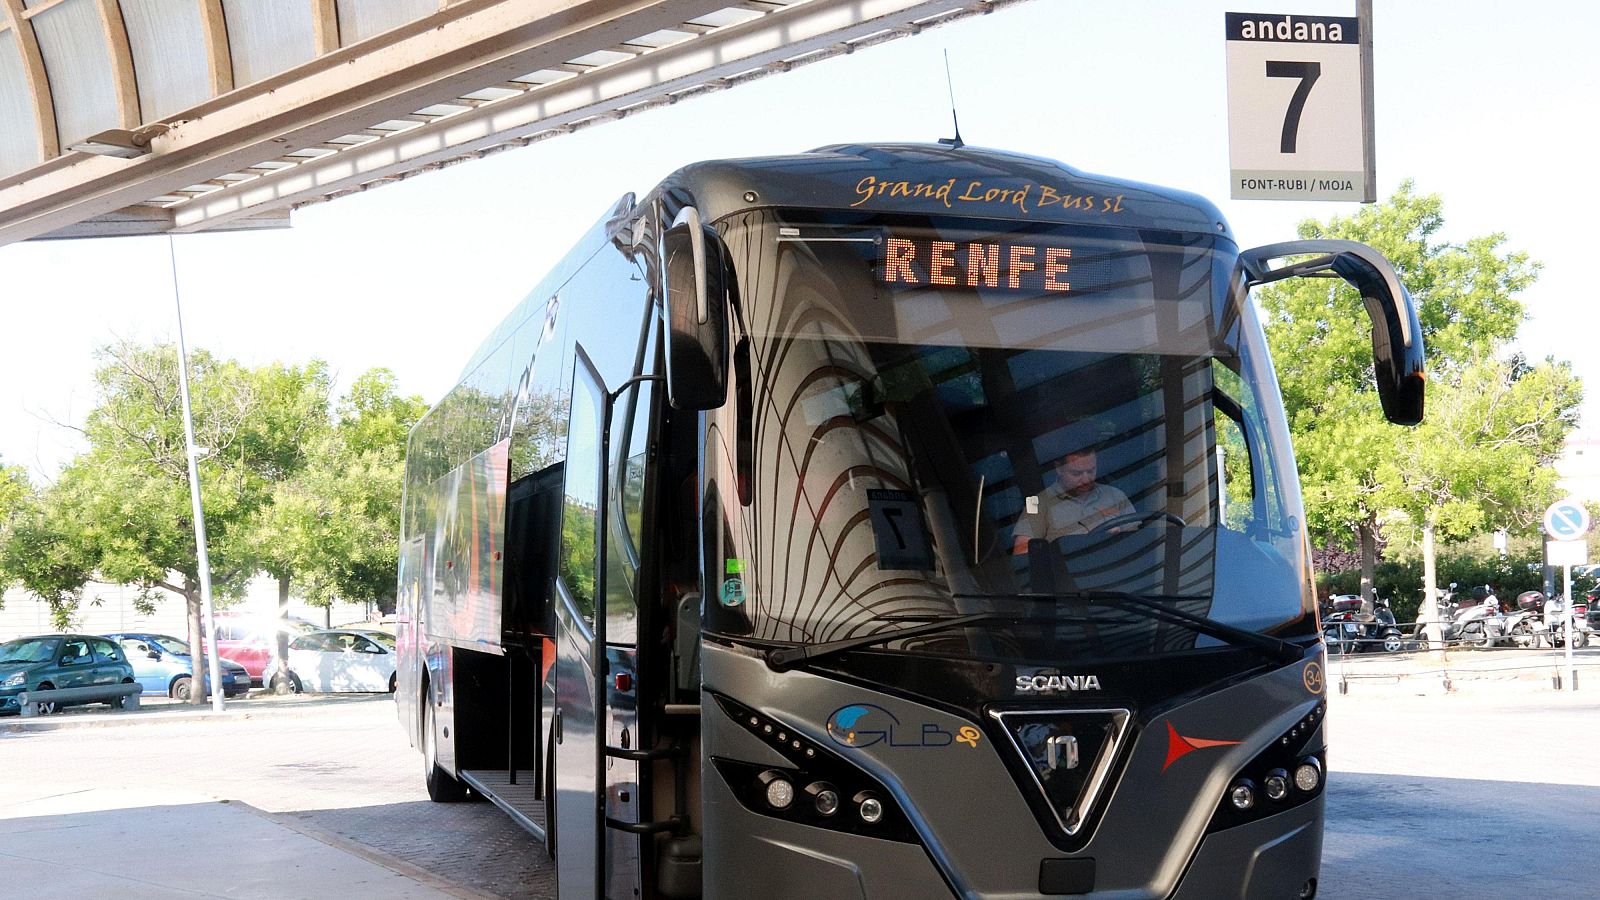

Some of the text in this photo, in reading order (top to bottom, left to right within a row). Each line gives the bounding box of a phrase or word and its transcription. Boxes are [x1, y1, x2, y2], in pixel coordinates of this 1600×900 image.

[1241, 16, 1342, 41] andana
[1265, 60, 1321, 153] 7
[850, 176, 955, 208] Grand
[958, 181, 1031, 214] Lord
[1037, 185, 1094, 208] Bus
[1241, 179, 1307, 190] FONT-RUBI
[1319, 181, 1353, 191] MOJA
[885, 238, 1072, 291] RENFE
[1015, 675, 1101, 692] SCANIA
[1306, 670, 1321, 686] 34
